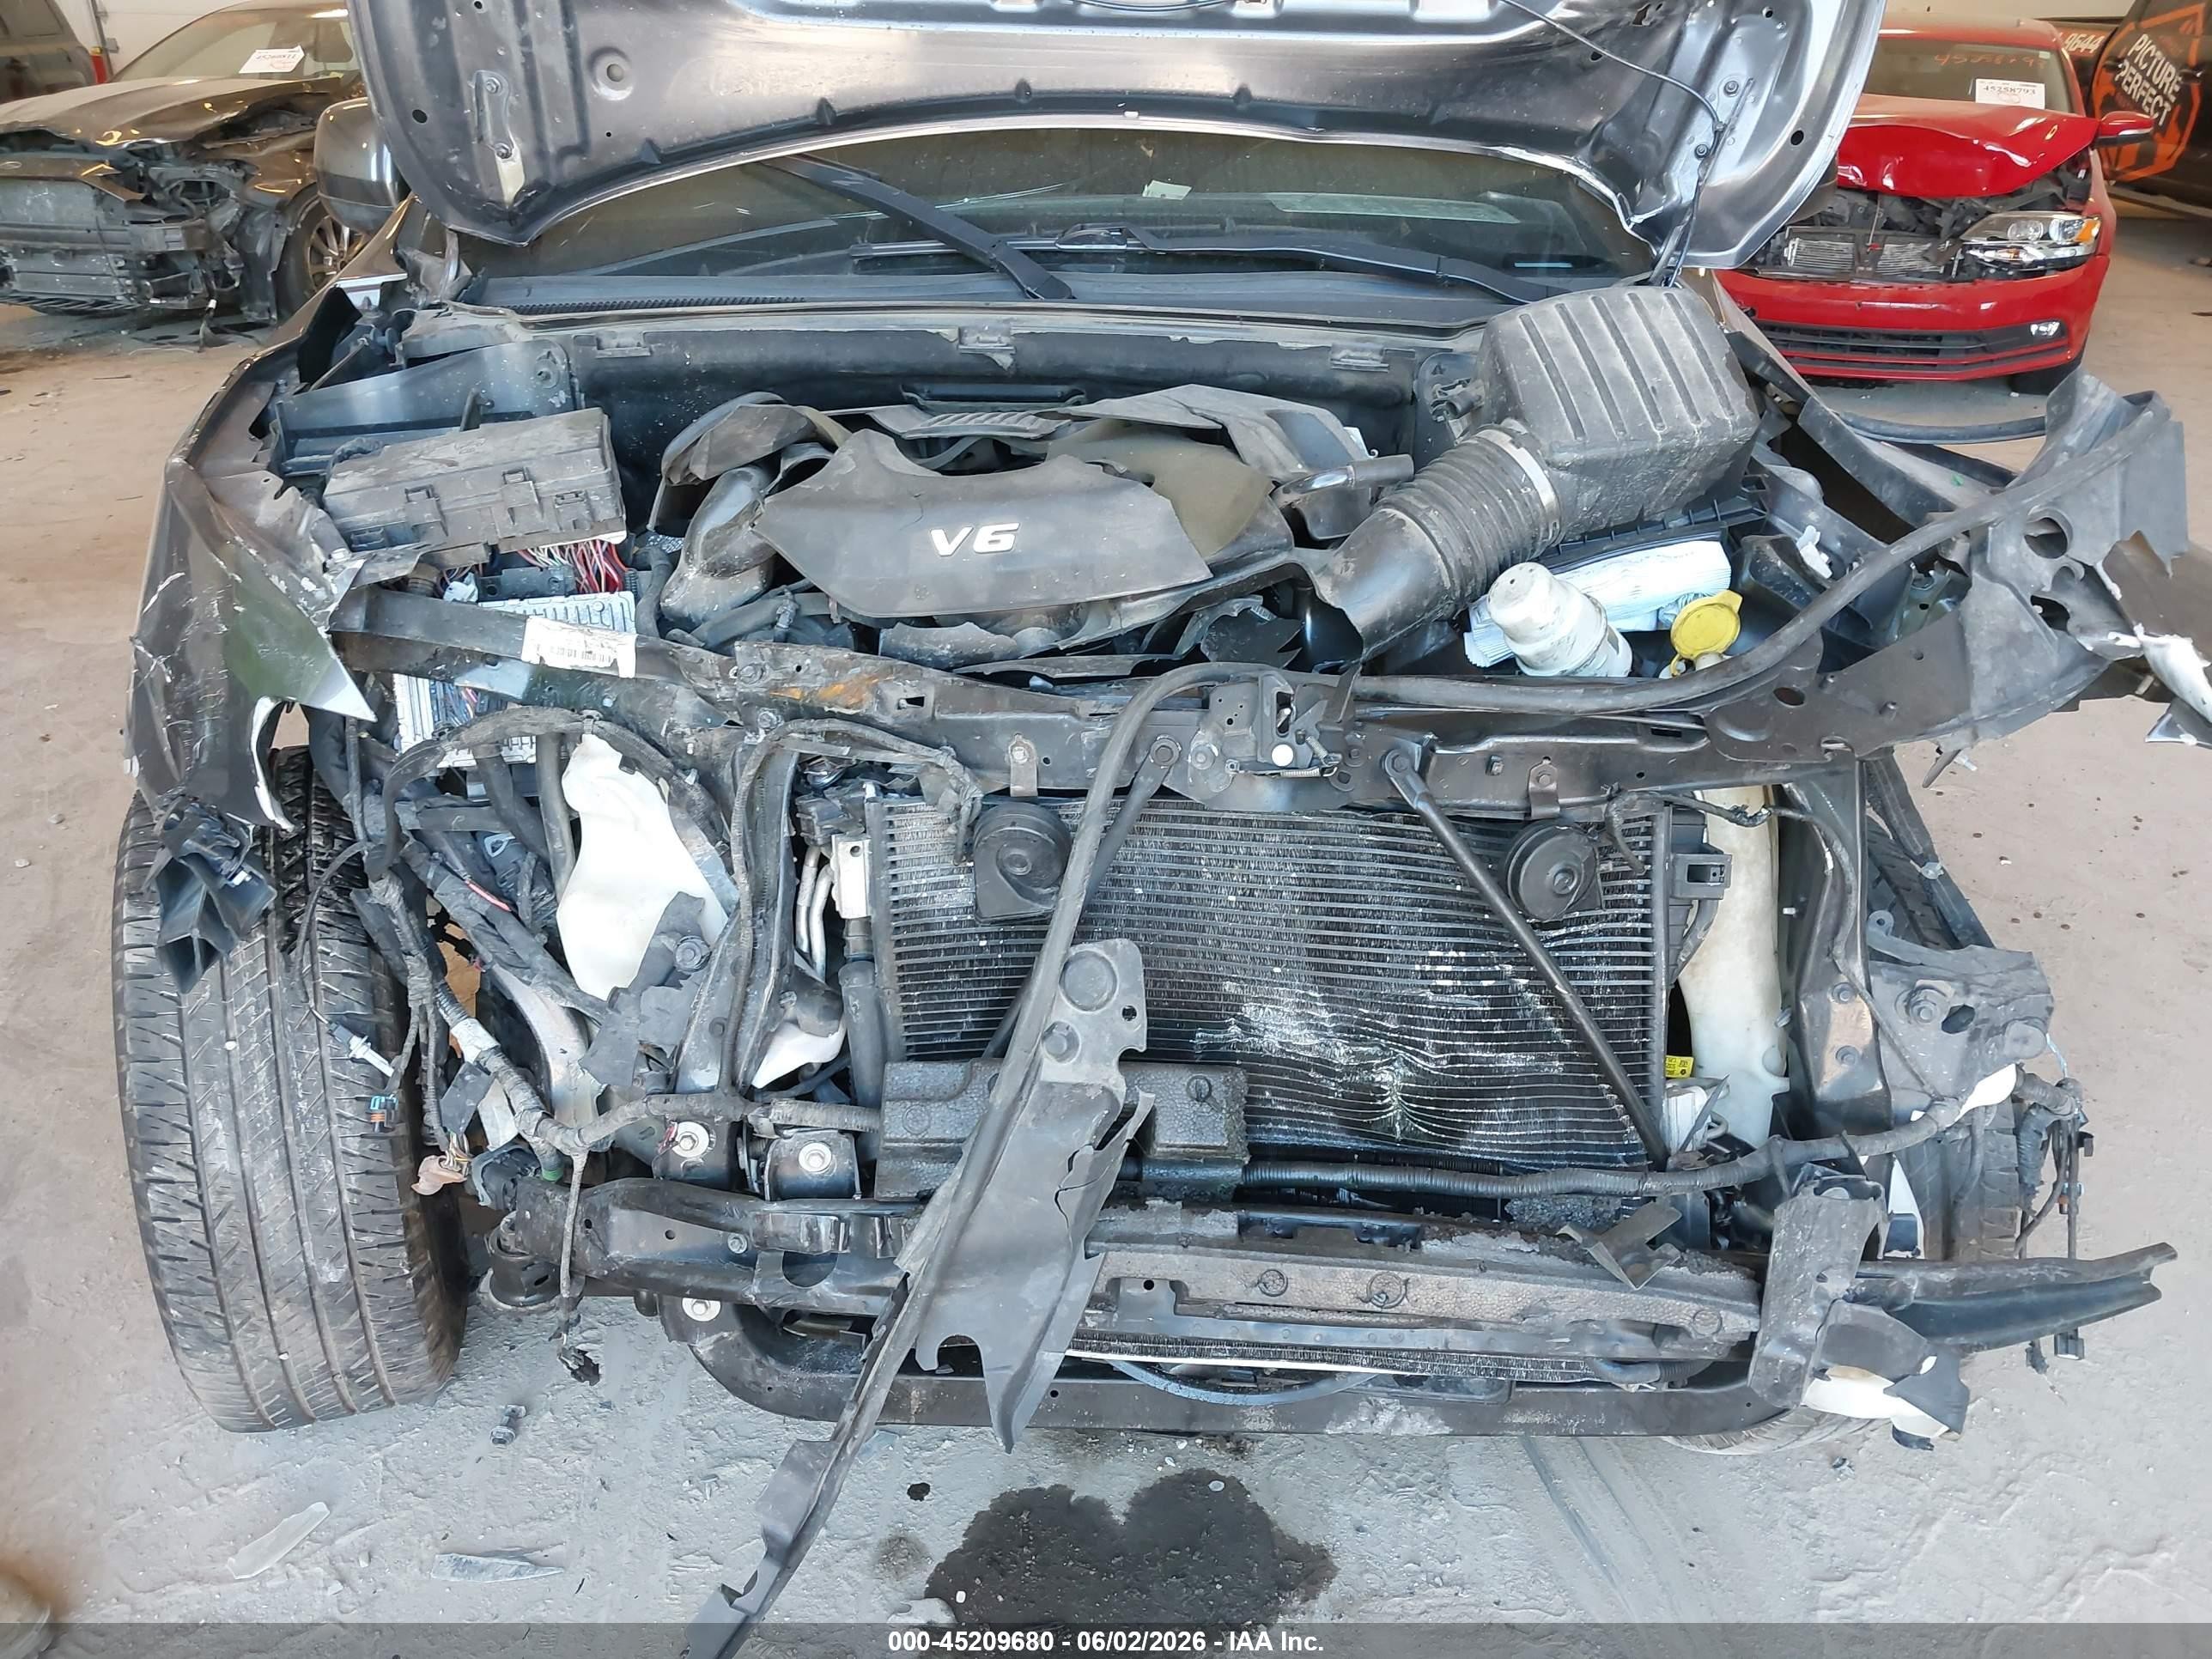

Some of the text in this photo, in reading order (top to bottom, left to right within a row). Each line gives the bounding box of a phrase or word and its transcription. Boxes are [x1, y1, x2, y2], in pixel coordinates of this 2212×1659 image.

[2114, 59, 2172, 126] PERFECT
[2127, 33, 2182, 103] PICTURE
[930, 522, 1020, 557] V6
